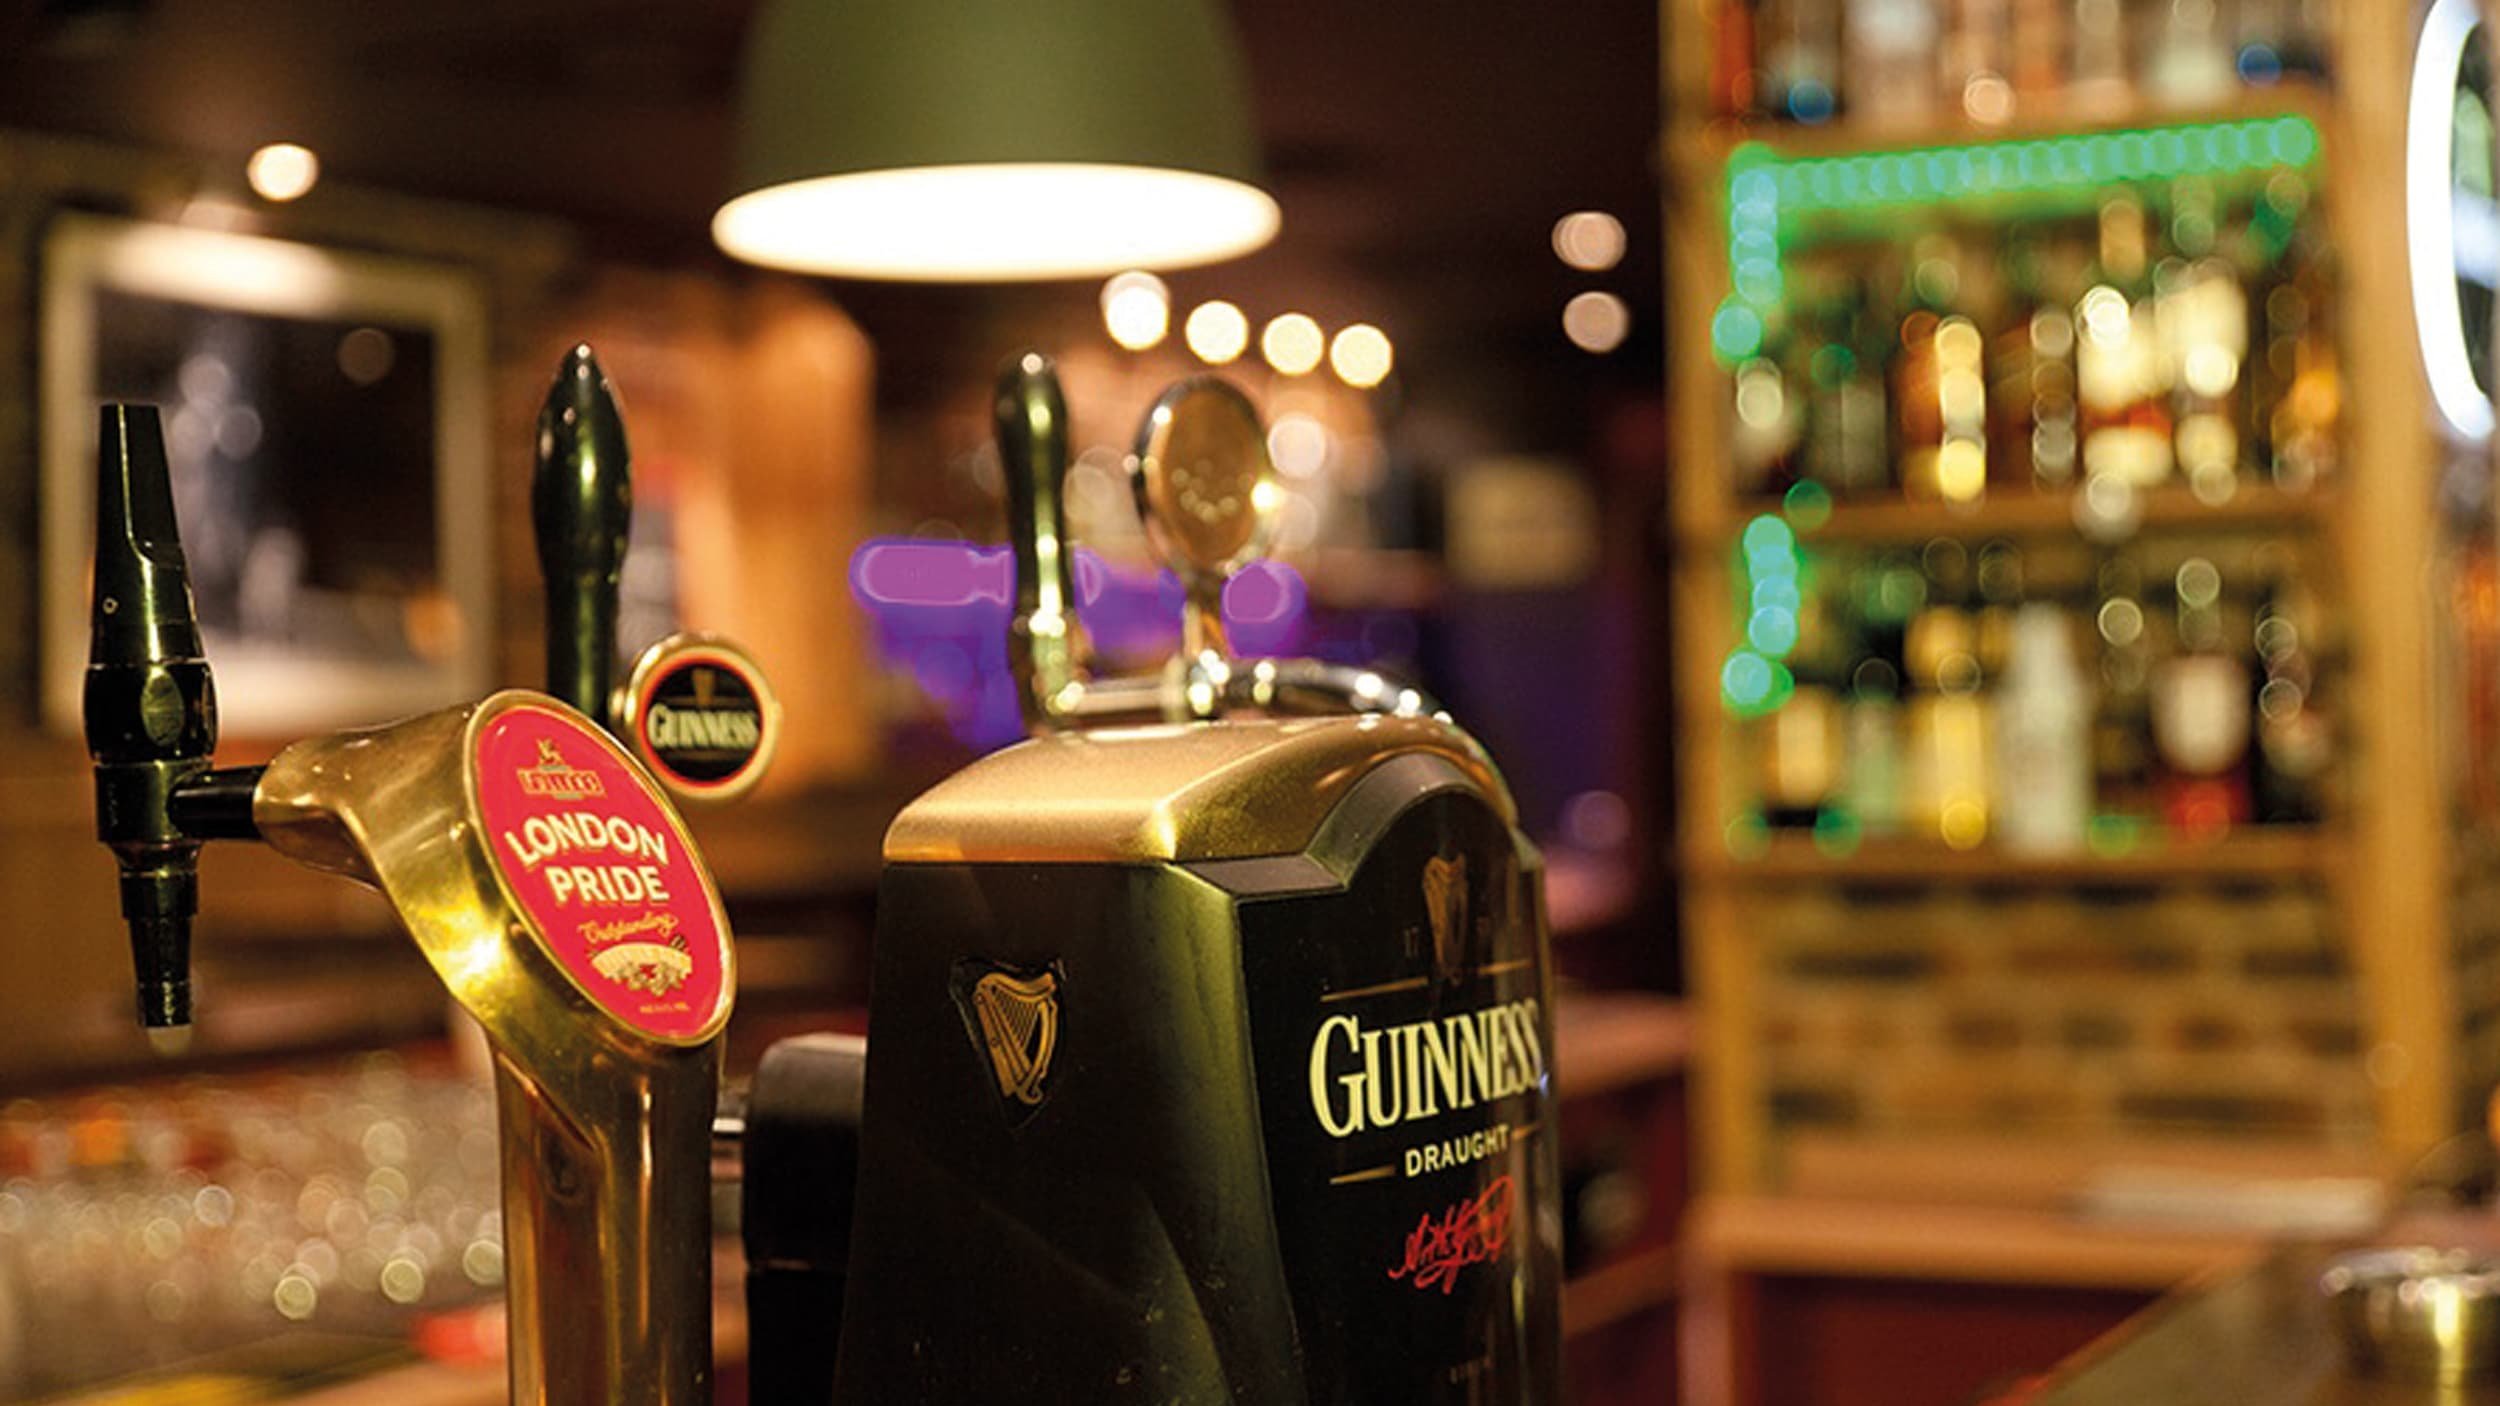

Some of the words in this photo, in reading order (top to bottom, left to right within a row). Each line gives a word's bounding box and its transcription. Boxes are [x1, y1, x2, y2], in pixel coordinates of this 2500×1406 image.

[504, 812, 668, 867] LONDON
[545, 866, 669, 903] PRIDE
[1309, 997, 1543, 1138] GUINNESS
[1405, 1124, 1509, 1178] DRAUGHT
